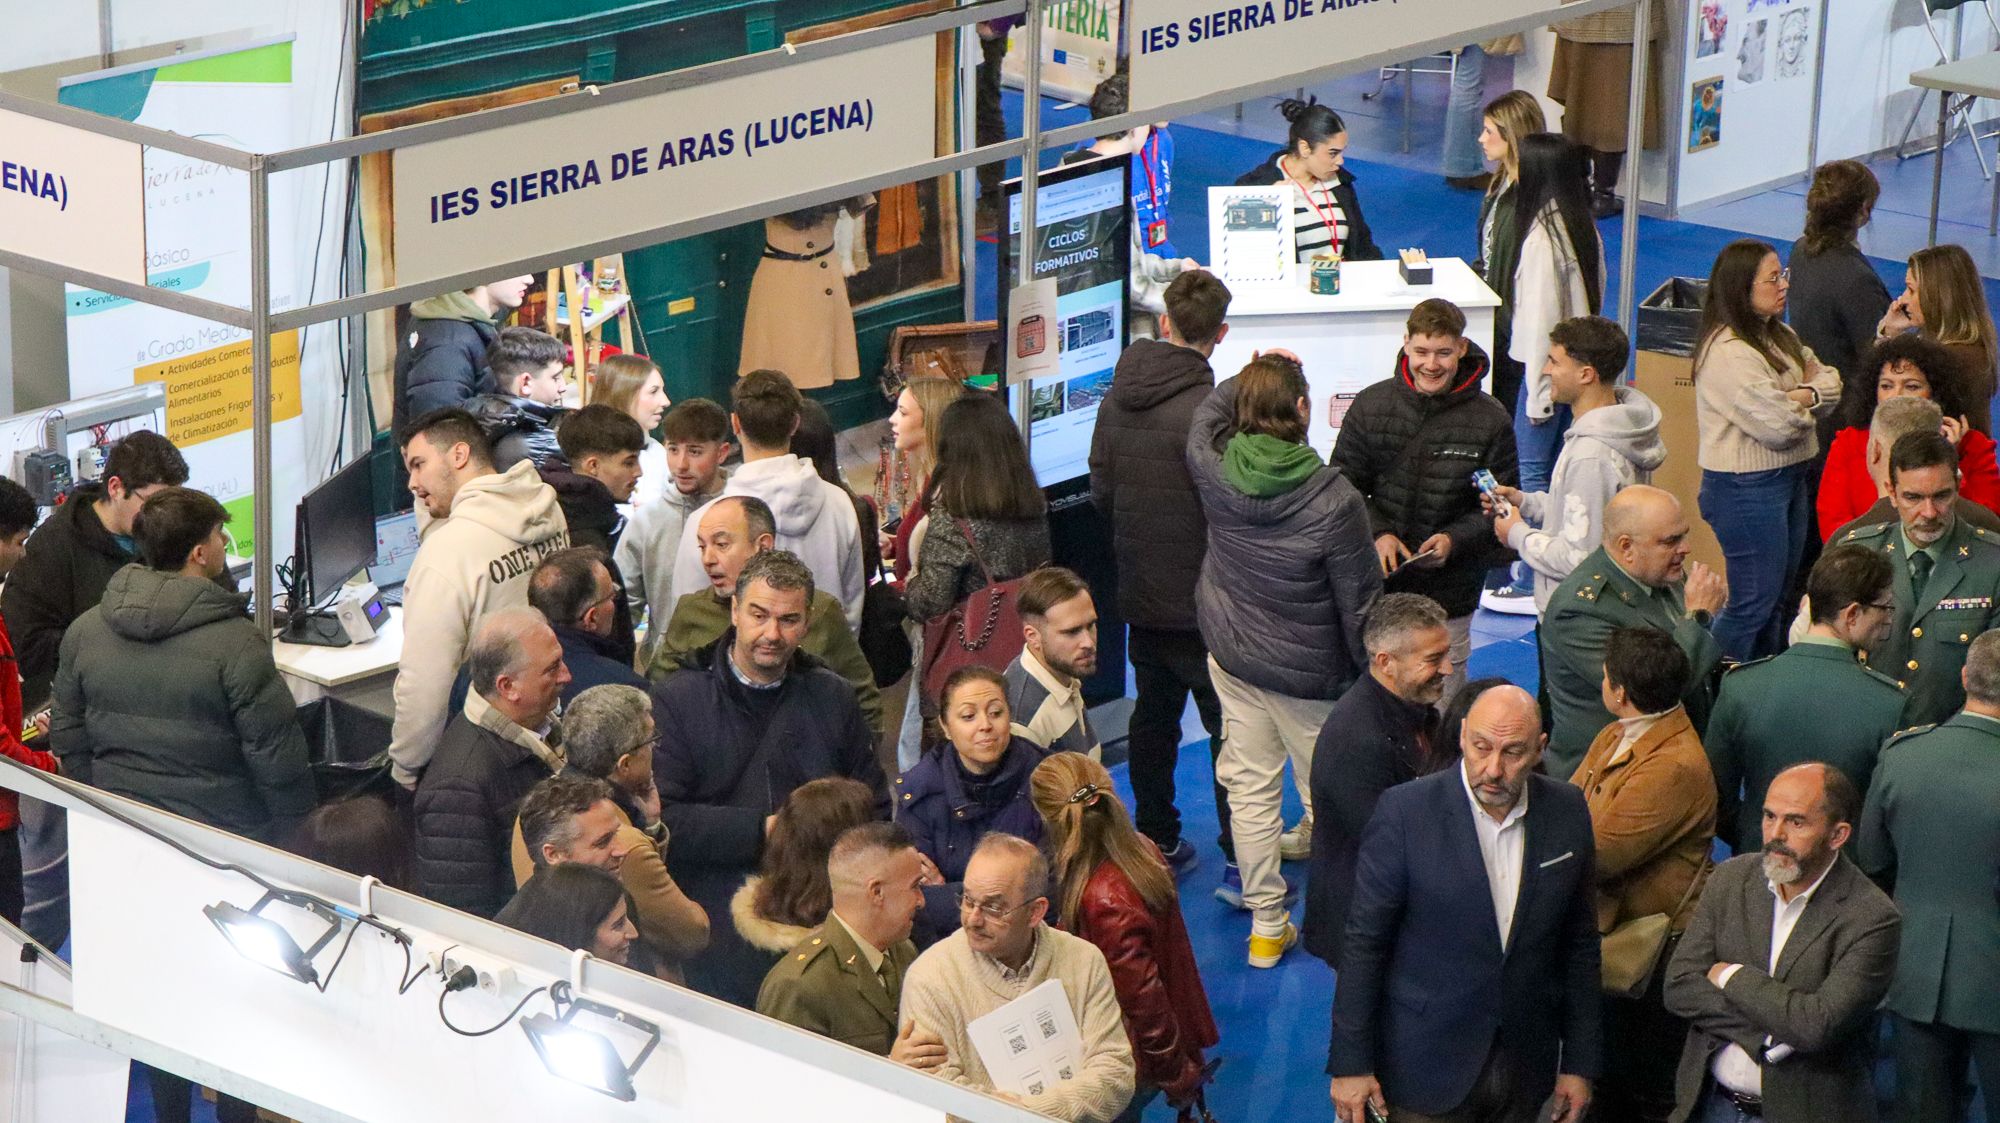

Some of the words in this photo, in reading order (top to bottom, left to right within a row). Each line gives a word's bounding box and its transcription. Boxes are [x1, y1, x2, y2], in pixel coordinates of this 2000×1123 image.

[1141, 21, 1180, 54] IES
[1187, 1, 1276, 44] SIERRA
[1284, 0, 1314, 22] DE
[430, 187, 479, 223] IES
[490, 160, 601, 209] SIERRA
[611, 147, 648, 180] DE
[658, 129, 734, 170] ARAS
[745, 98, 873, 157] (LUCENA)
[2, 161, 68, 211] ENA)
[146, 165, 192, 189] ierra
[1049, 229, 1086, 248] CICLOS
[1035, 247, 1099, 274] FORMATIVOS
[148, 334, 195, 358] Grado
[198, 326, 241, 346] Medio
[168, 356, 217, 376] Actividades
[219, 346, 253, 362] Comerc
[168, 369, 240, 395] Comercialización
[242, 364, 253, 375] de
[168, 388, 222, 409] Alimentarios
[170, 402, 226, 428] Instalaciones
[278, 391, 284, 402] y
[183, 416, 239, 441] Climatización
[489, 545, 534, 584] ONE
